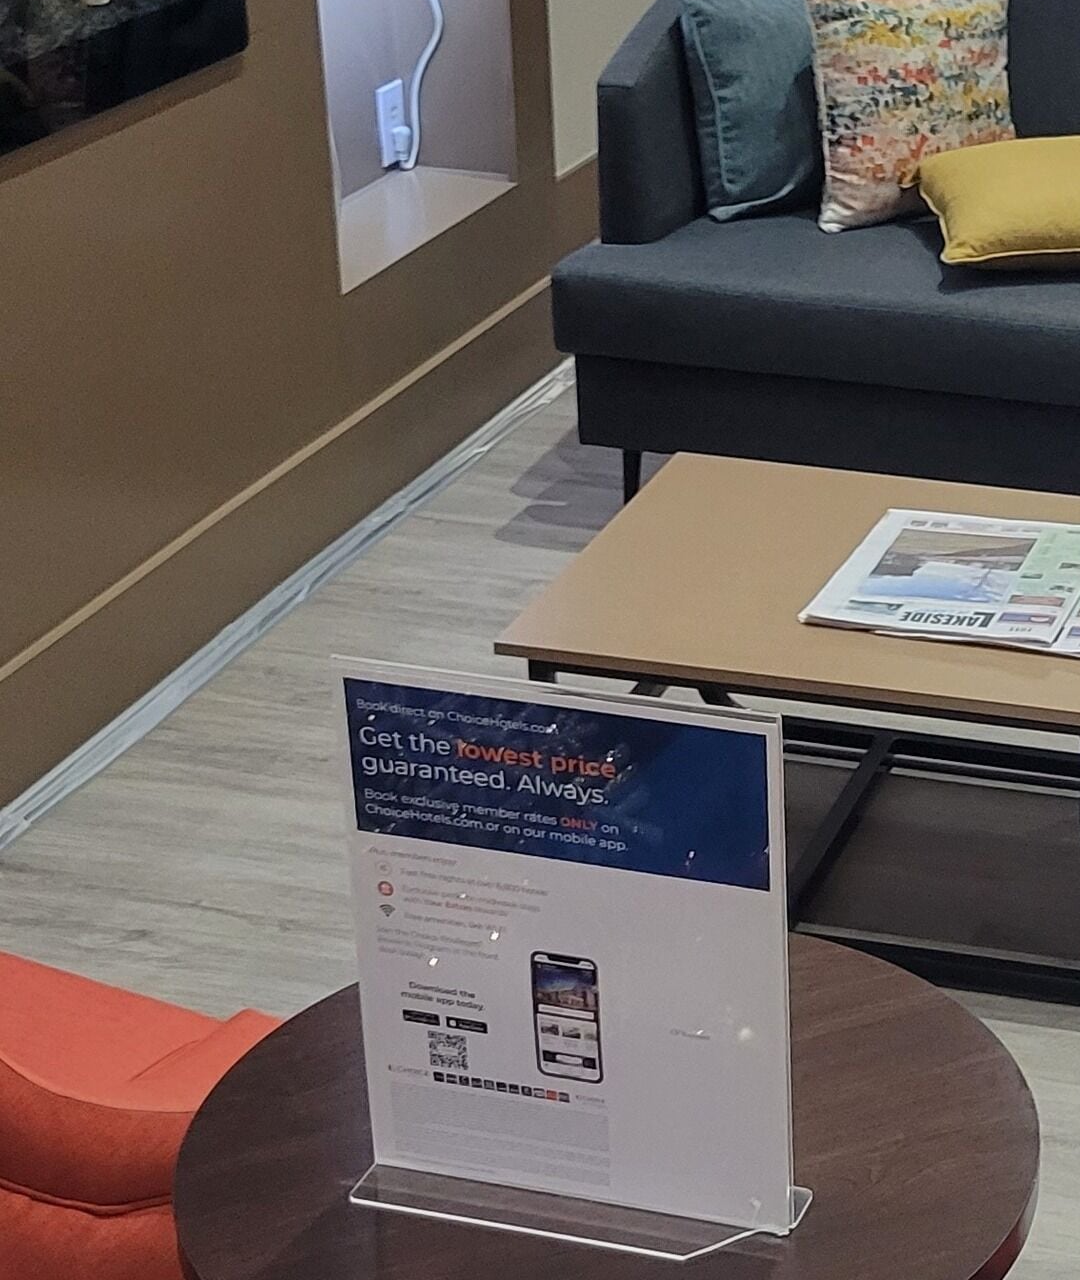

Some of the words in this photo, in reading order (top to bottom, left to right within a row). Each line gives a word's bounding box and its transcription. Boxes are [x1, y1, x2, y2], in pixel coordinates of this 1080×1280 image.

[902, 611, 996, 628] LAKESIDE
[356, 698, 386, 712] Book
[359, 726, 402, 749] Get
[409, 733, 450, 755] the
[455, 738, 543, 768] lowest
[361, 755, 511, 791] guaranteed.
[517, 774, 609, 805] Always.
[364, 788, 398, 801] Book
[401, 794, 459, 813] exclusive
[463, 803, 520, 820] member
[524, 812, 557, 826] rates
[560, 816, 598, 830] ONLY
[601, 824, 620, 834] on
[503, 824, 520, 835] on
[523, 827, 546, 839] our
[549, 831, 597, 847] mobile
[599, 838, 629, 852] app.
